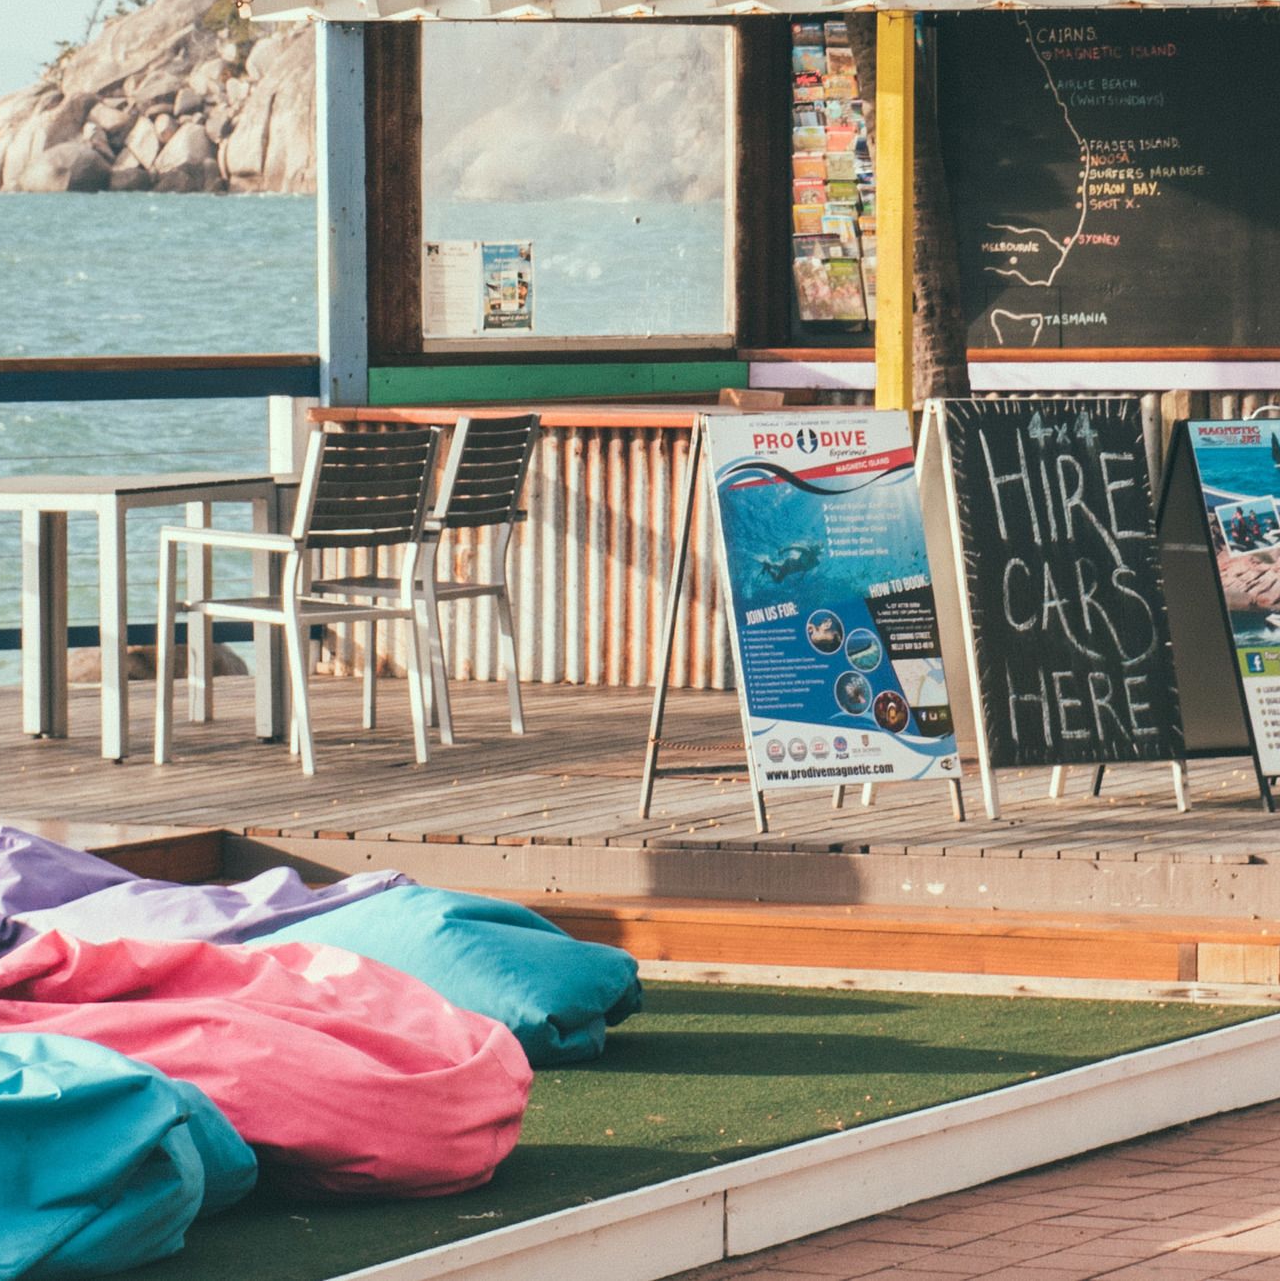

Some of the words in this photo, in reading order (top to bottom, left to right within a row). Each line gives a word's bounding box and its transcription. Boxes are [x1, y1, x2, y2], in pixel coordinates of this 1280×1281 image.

[1053, 46, 1122, 60] MAGNETIC
[1057, 78, 1095, 90] AIRLIE
[1090, 139, 1135, 153] FRASER
[1088, 168, 1144, 180] SURFERS
[1089, 182, 1126, 195] BYRON
[1089, 199, 1120, 210] SPOT
[1078, 233, 1120, 246] SYDNEY
[981, 241, 1040, 253] MELBOURNE
[1044, 312, 1108, 325] TASMANIA
[753, 432, 794, 449] PRO
[821, 430, 867, 447] DIVE
[829, 448, 867, 459] Experience
[835, 461, 867, 472] MAGNETIC
[979, 428, 1156, 564] HIRE
[869, 582, 890, 598] HOW
[890, 579, 904, 593] TO
[903, 574, 931, 591] BOOK:
[745, 608, 765, 626] JOIN
[764, 605, 778, 621] US
[1003, 557, 1157, 667] CARS
[1006, 662, 1159, 747] HERE
[766, 762, 894, 781] www.prodivemagnetic.com
